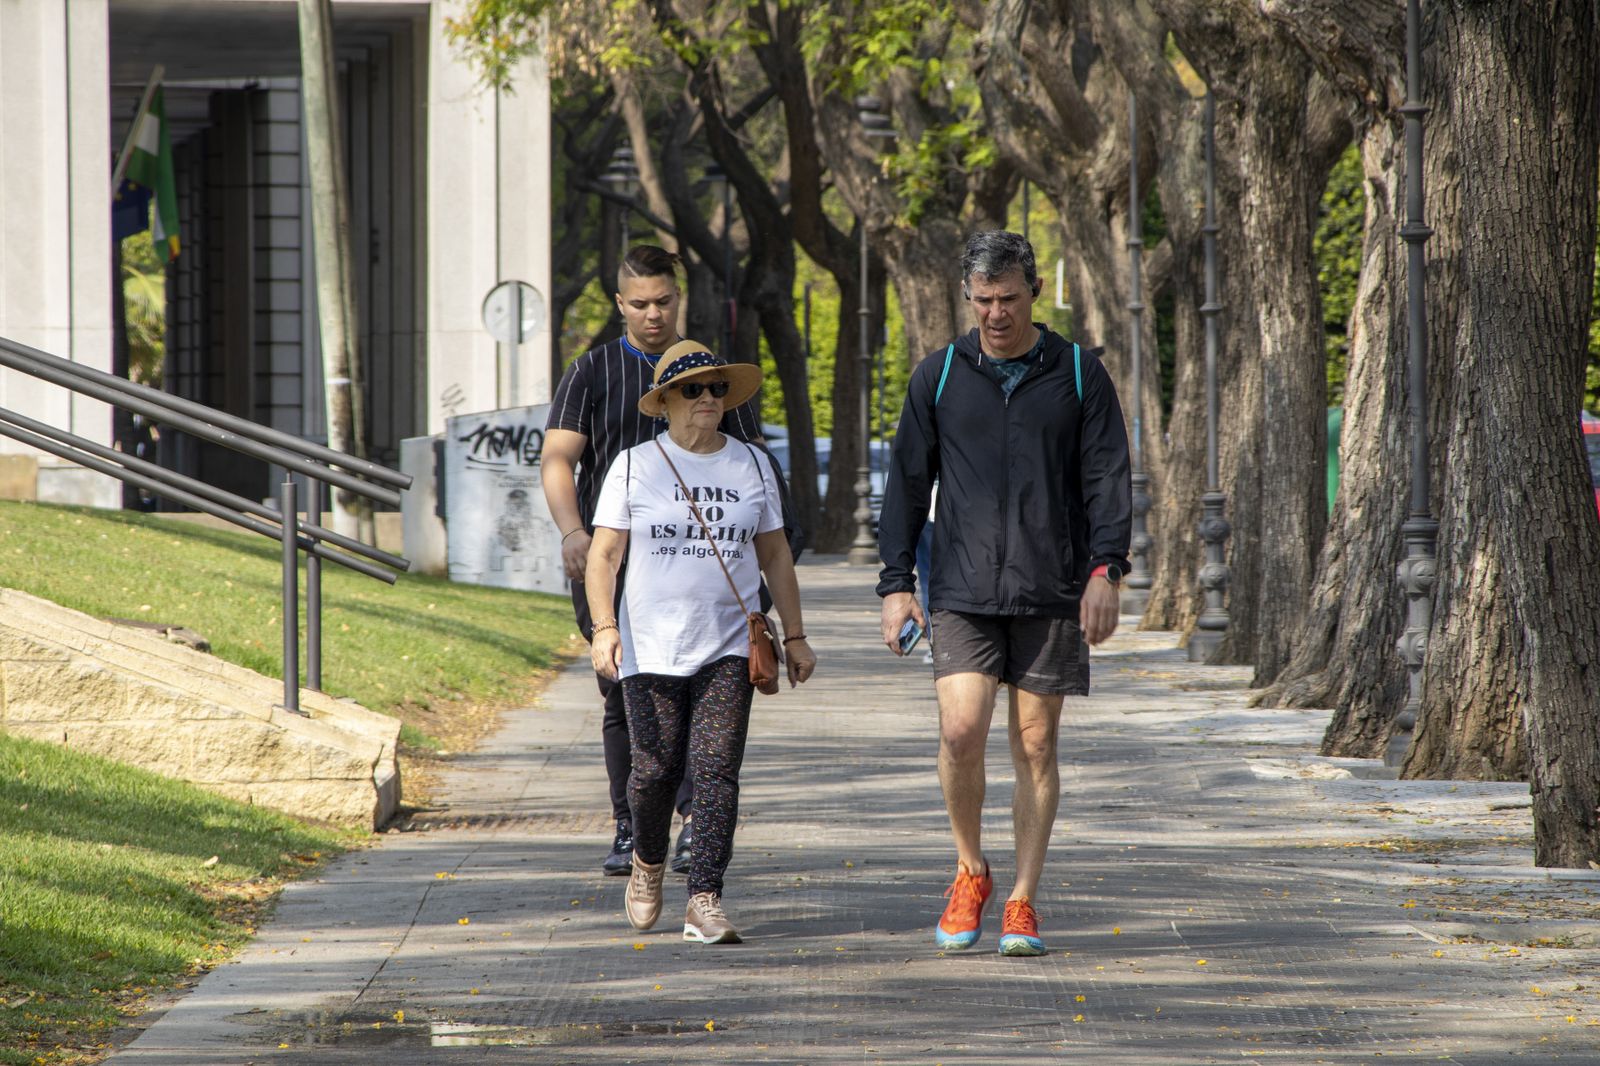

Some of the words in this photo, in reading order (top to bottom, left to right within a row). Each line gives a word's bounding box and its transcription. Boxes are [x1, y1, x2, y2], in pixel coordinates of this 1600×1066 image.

[687, 505, 724, 522] NO
[651, 524, 677, 539] ES
[682, 545, 715, 559] algo
